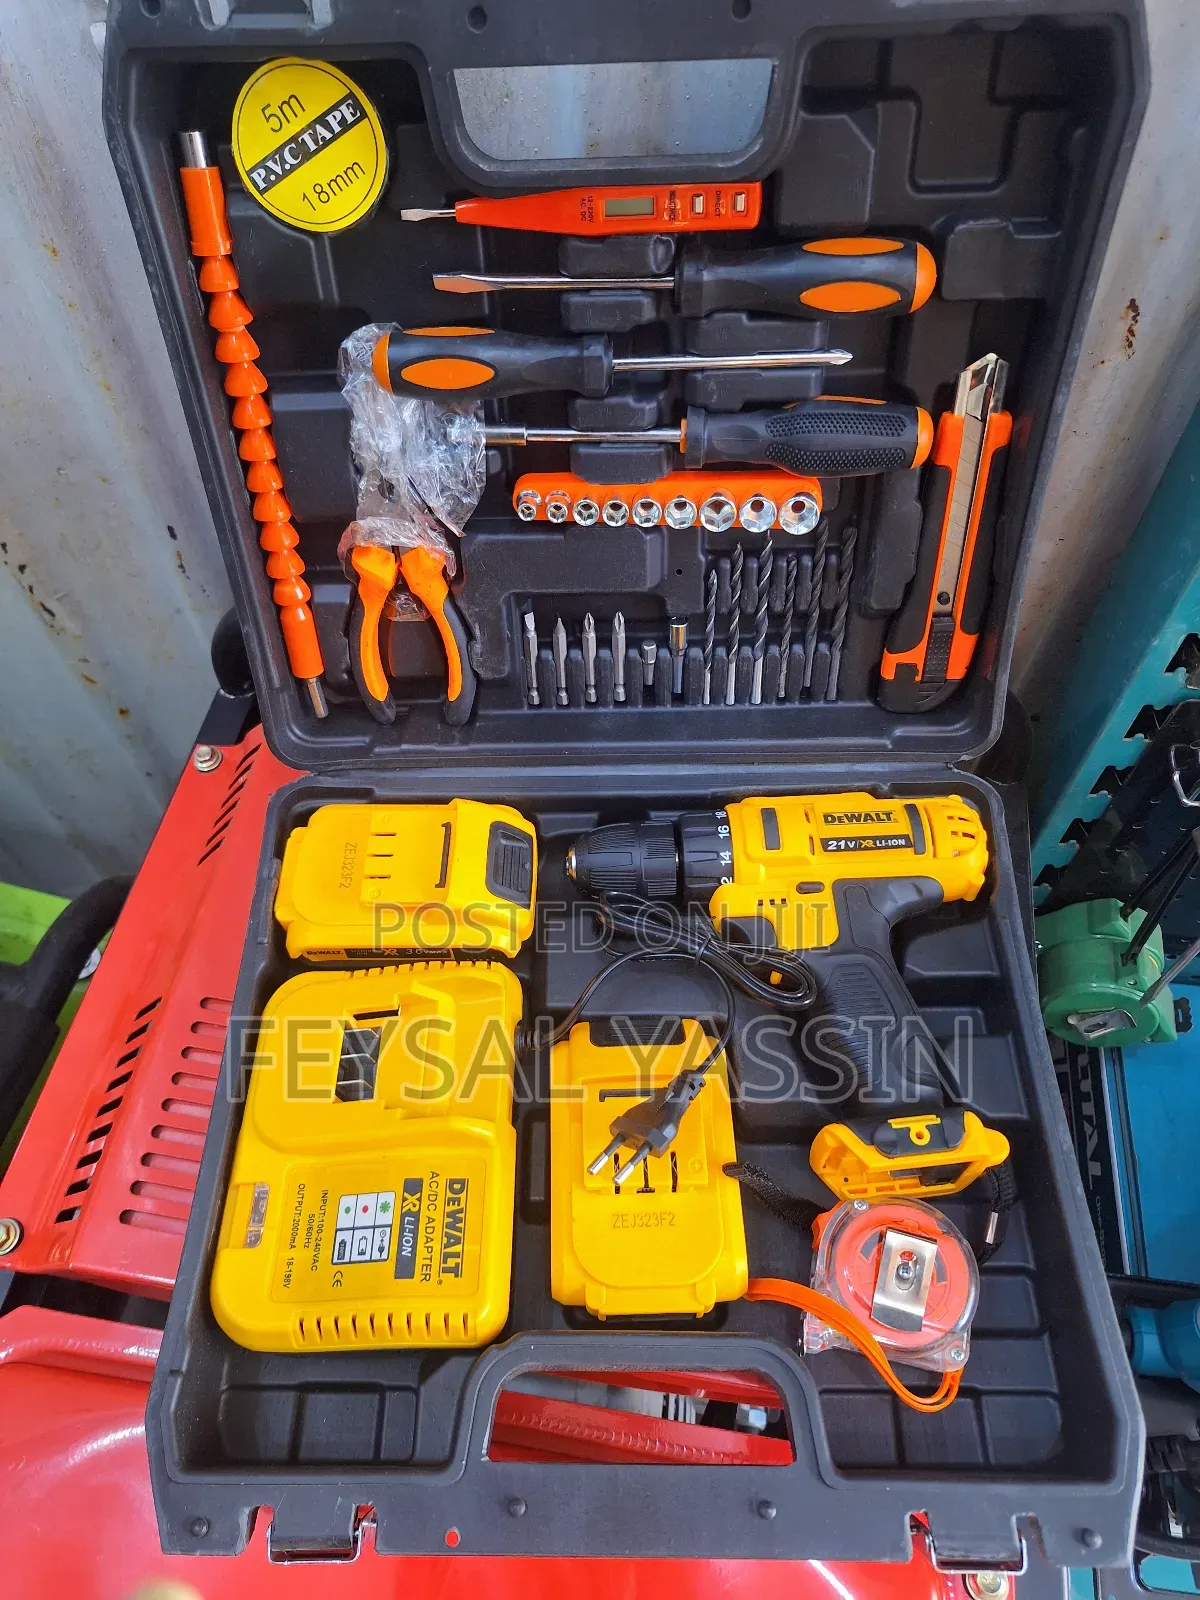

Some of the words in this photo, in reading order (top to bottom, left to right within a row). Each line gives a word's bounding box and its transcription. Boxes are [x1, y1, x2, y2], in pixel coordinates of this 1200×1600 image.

[261, 94, 306, 133] 5m
[250, 143, 303, 191] P.V.C
[298, 99, 361, 152] TAPE
[301, 161, 366, 212] 18mm
[714, 810, 727, 820] 18
[717, 824, 730, 840] 16
[719, 850, 732, 867] 14
[876, 838, 906, 847] LI-ION
[1077, 1046, 1102, 1190] OTAL
[427, 1170, 440, 1212] AC/DC
[288, 1183, 306, 1250] OUTPUT:2000mA
[303, 1213, 315, 1250] 50/60Hz
[401, 1216, 415, 1257] LI-ION
[612, 1212, 676, 1229] ZEJ323F2
[420, 1216, 436, 1283] ADAPTER
